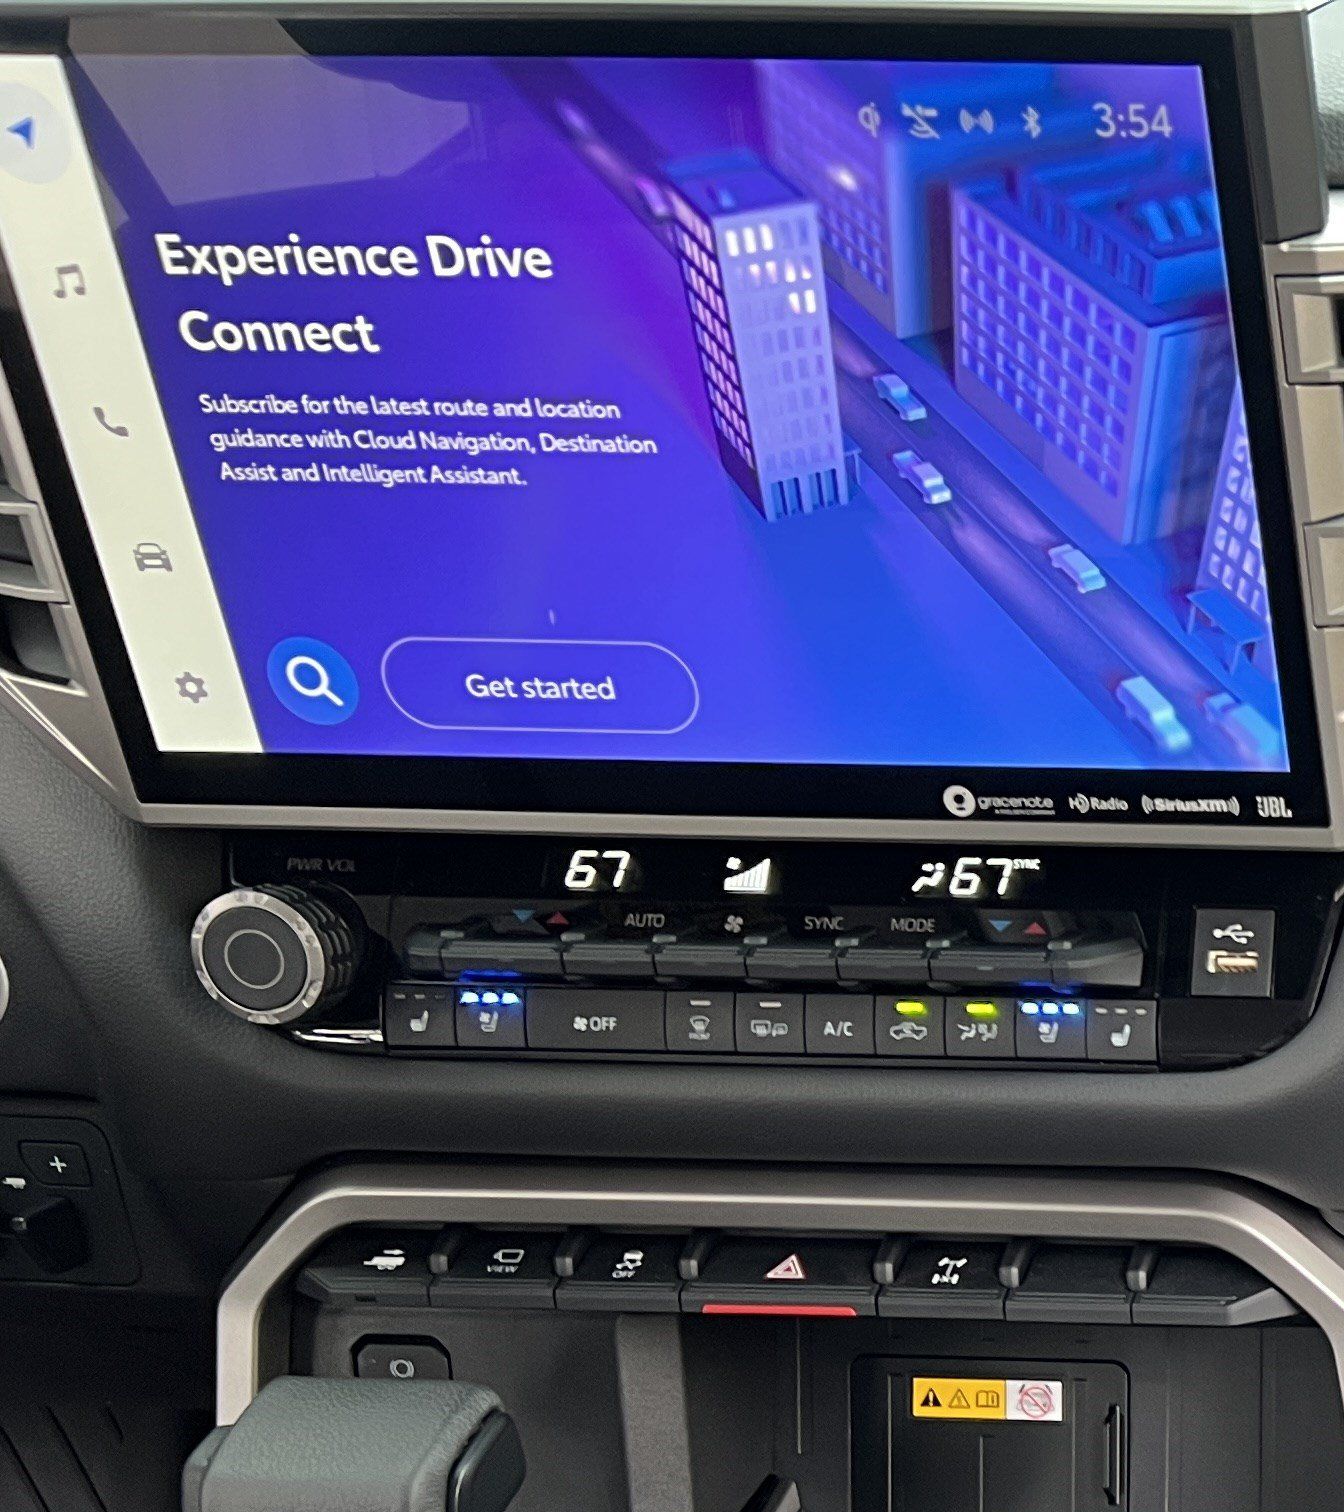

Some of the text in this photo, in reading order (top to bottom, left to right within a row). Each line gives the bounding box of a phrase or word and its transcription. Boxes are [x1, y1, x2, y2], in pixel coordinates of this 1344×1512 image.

[1092, 103, 1174, 138] 3:54
[155, 233, 554, 286] Experience Drive
[178, 310, 381, 354] Connect
[198, 393, 622, 419] Subscribe for the latest route and location
[210, 428, 658, 455] guidance with Cloud Navigation, Destination
[221, 461, 528, 488] Assist and Intelligent Assistant.
[465, 673, 616, 702] Get started
[1089, 797, 1129, 811] Radio
[564, 850, 631, 890] 67
[949, 857, 1016, 896] 67
[624, 913, 666, 928] AUTO
[804, 915, 845, 931] SYNC
[890, 917, 936, 933] MODE
[589, 1016, 618, 1033] OFF
[823, 1020, 854, 1037] A/C
